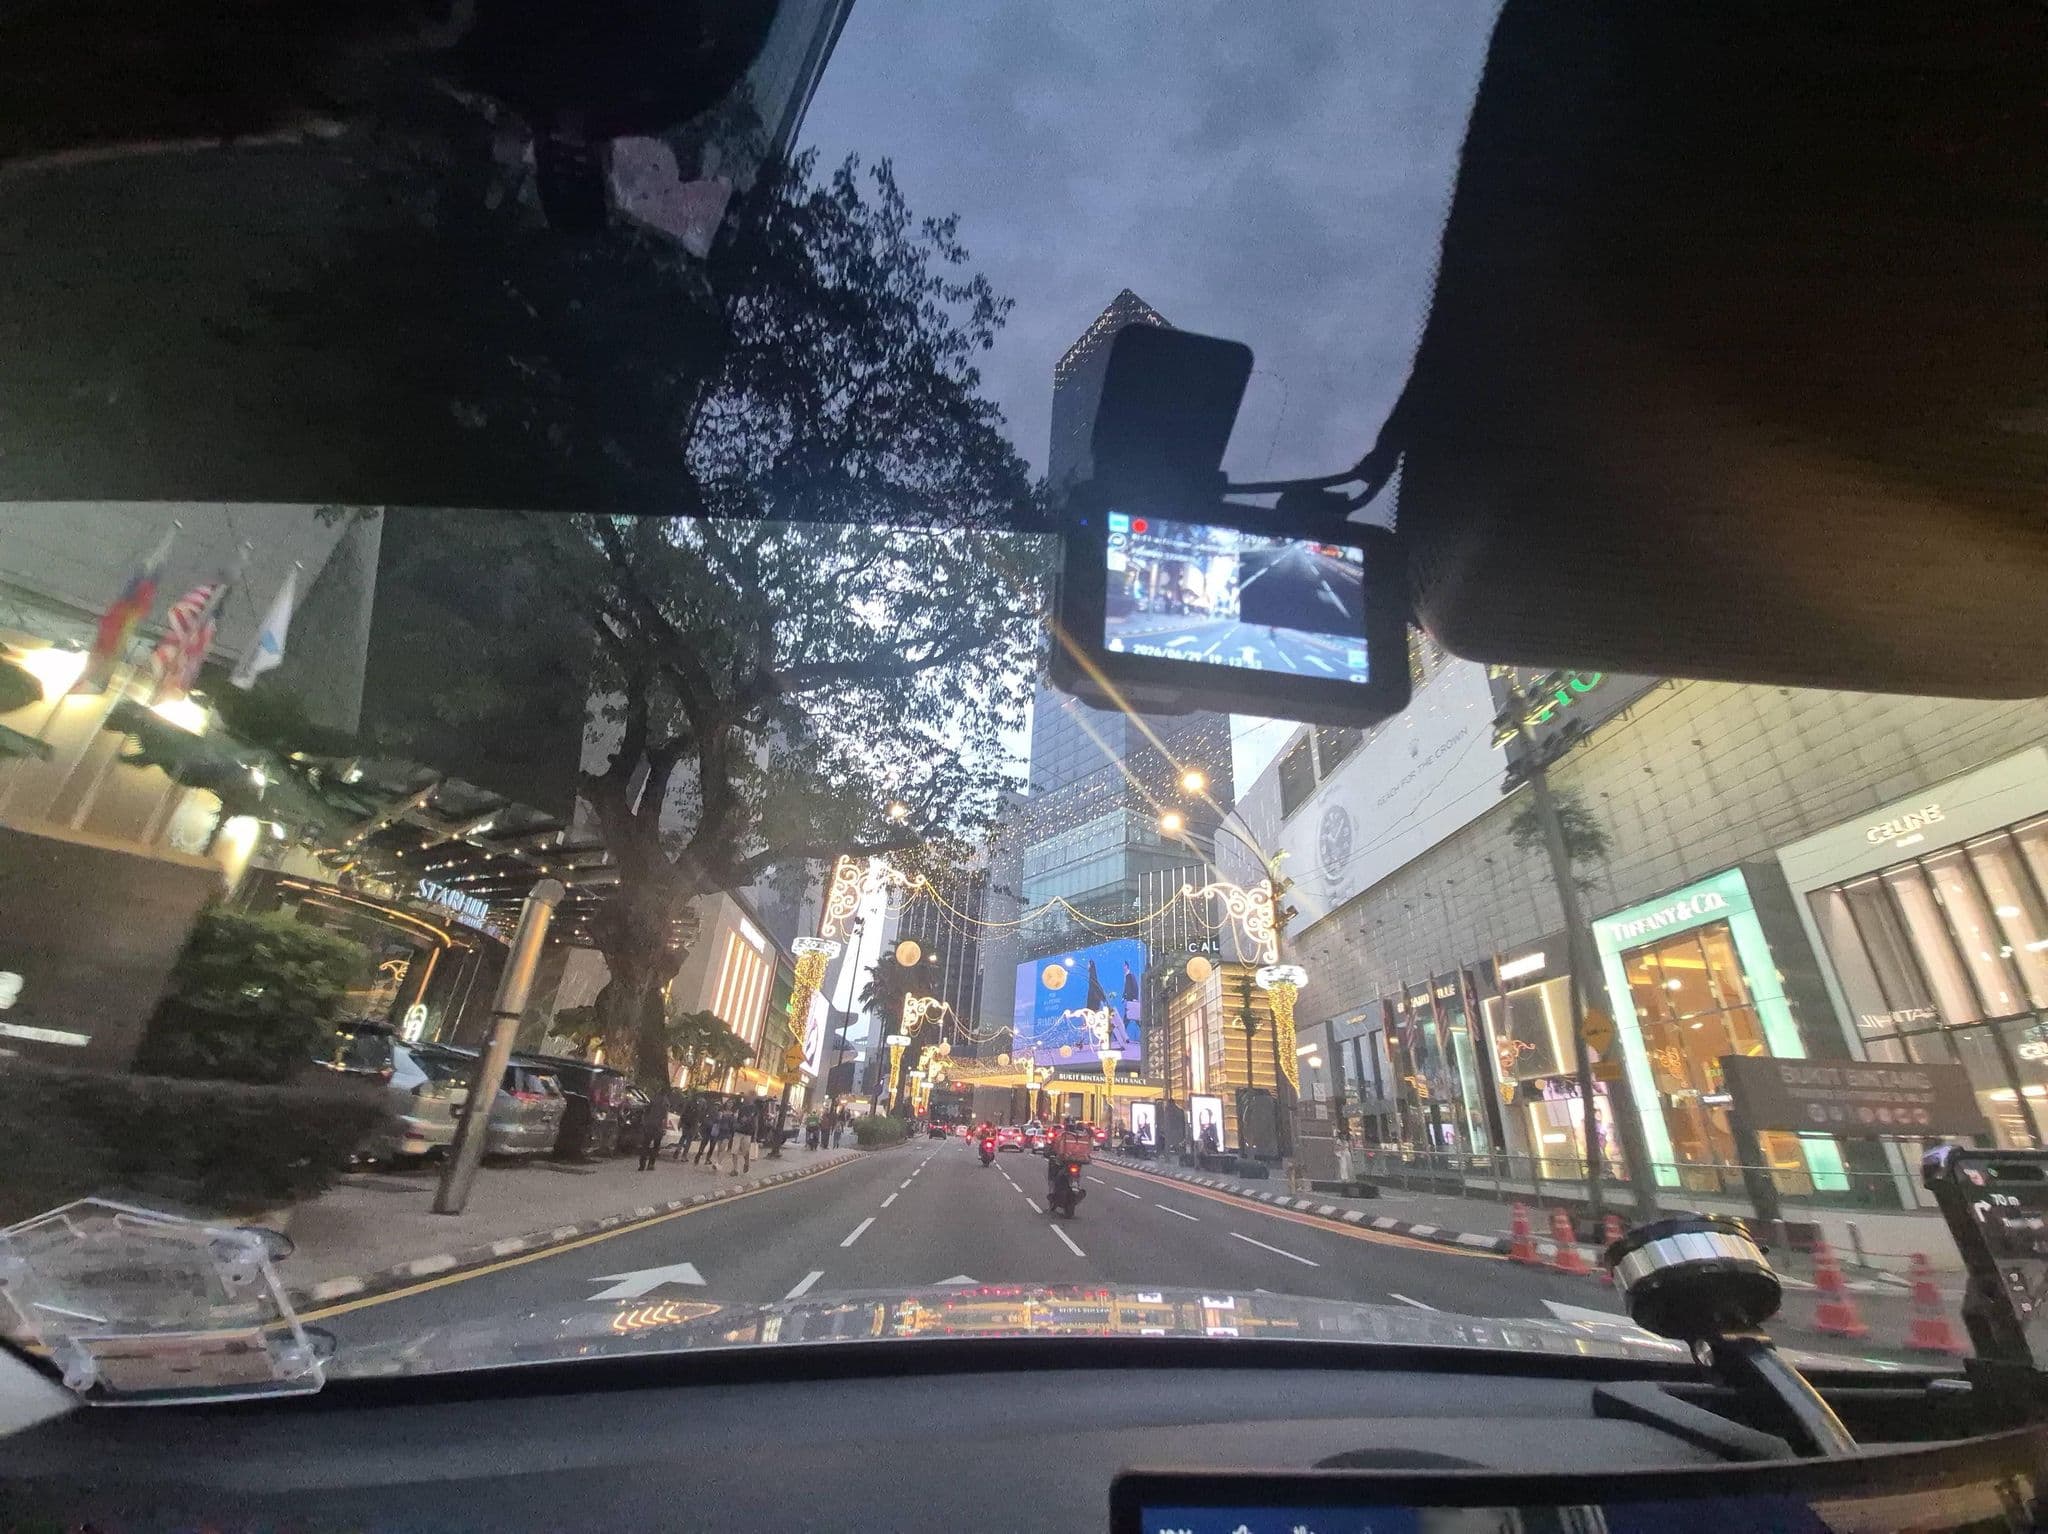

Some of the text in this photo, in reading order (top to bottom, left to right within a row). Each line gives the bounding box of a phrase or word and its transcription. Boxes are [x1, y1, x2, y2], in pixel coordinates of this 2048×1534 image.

[1400, 769, 1417, 788] FOR
[1434, 726, 1468, 759] CROWN
[1866, 803, 1945, 843] CELINE
[1059, 1073, 1147, 1086] BUKIT BINTAN NTRANCE
[1988, 1193, 2020, 1206] 70 m
